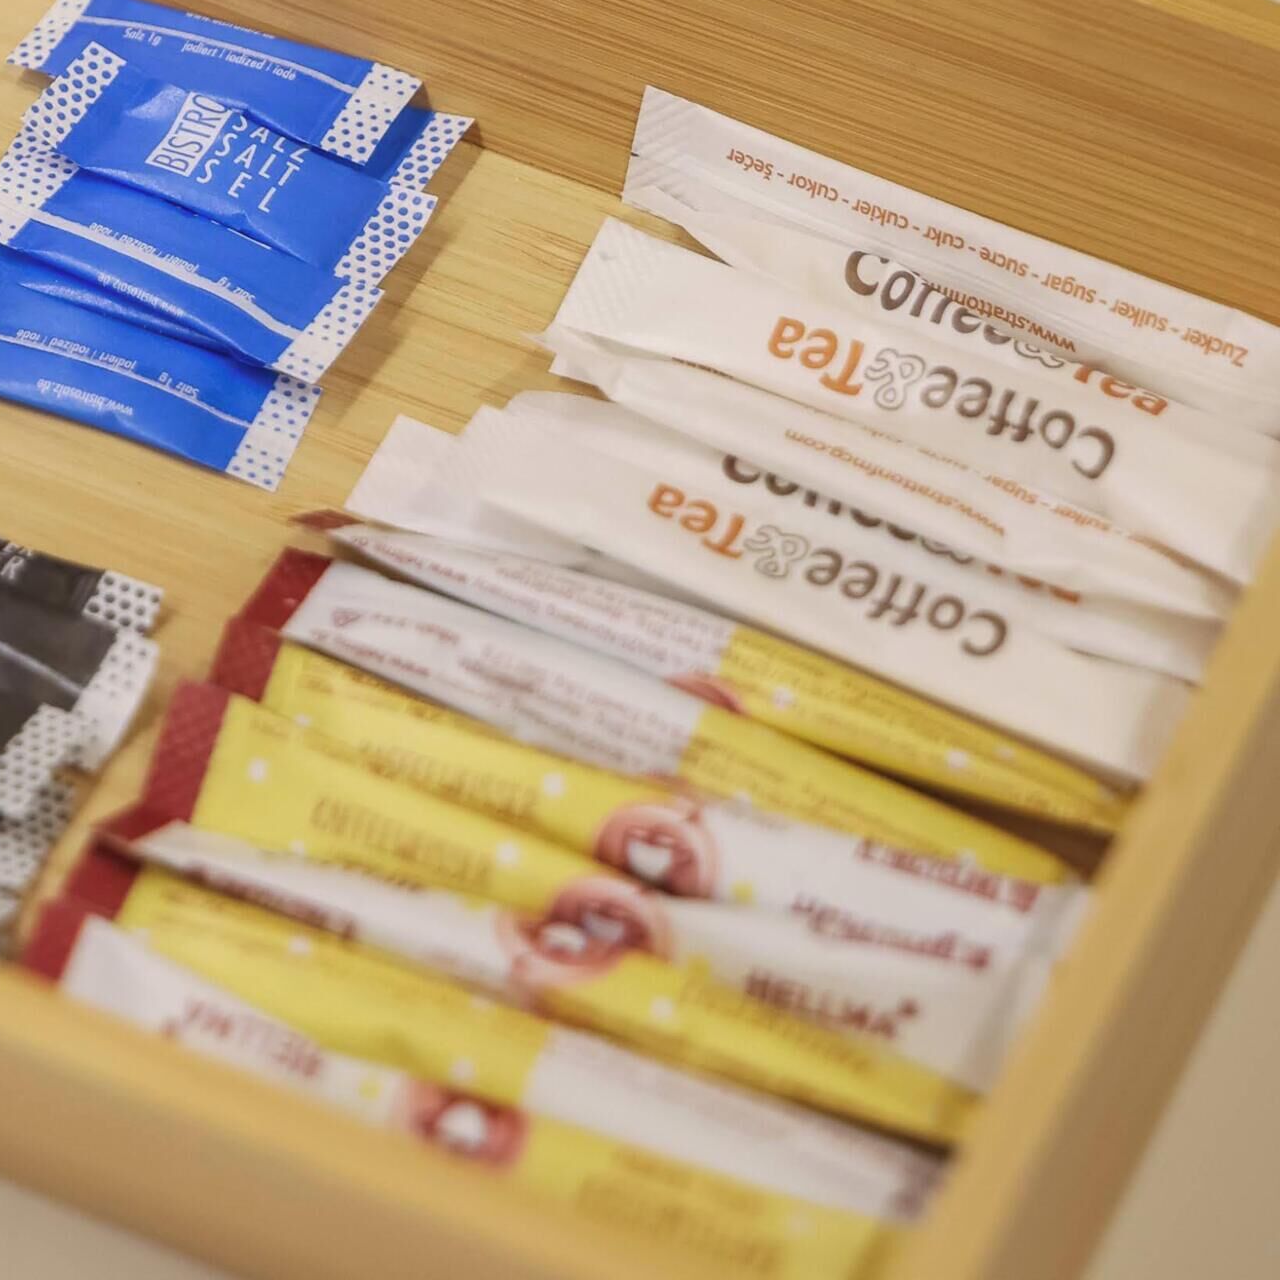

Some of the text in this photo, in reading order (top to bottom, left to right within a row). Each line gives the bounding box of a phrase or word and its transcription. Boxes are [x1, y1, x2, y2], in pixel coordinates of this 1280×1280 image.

[122, 26, 145, 40] Salz
[148, 31, 162, 47] 1g
[181, 40, 217, 58] jodiert
[225, 50, 266, 71] iodized
[151, 94, 229, 173] BISTRO
[214, 133, 300, 187] SALT
[196, 158, 277, 214] SEL
[787, 172, 839, 199] cukor
[851, 198, 910, 230] cukier
[922, 224, 965, 250] cukr
[978, 244, 1029, 277] sucre
[1040, 271, 1097, 305] sugar
[1109, 297, 1169, 332] suiker
[50, 336, 91, 355] iodized
[1181, 327, 1249, 368] Zucker
[36, 378, 134, 417] www.bistrosalz.de
[158, 371, 173, 389] 1g
[766, 315, 1116, 481] Coffee&Tea
[647, 481, 1009, 659] Coffee&Tea
